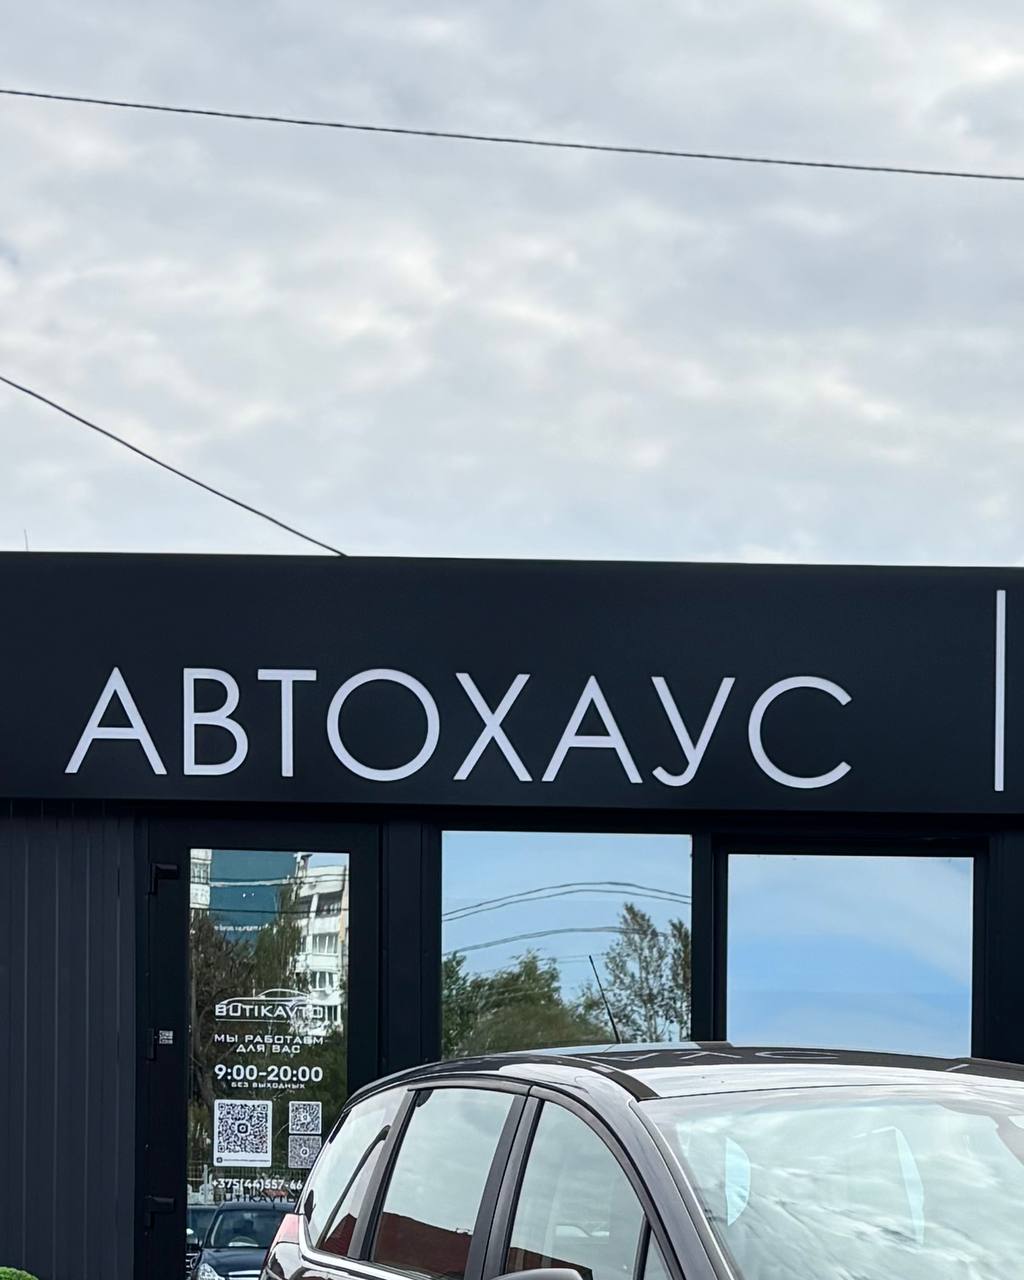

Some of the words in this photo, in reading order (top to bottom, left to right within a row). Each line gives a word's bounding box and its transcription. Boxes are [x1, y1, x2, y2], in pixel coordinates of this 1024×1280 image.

[64, 667, 852, 788] АВТОХАУС
[214, 1004, 323, 1019] BUTIKAVTO
[214, 1034, 239, 1043] МЫ
[245, 1034, 324, 1045] РАБОТАЕМ
[236, 1044, 266, 1053] ДЛЯ
[271, 1044, 301, 1053] ВАС
[214, 1064, 323, 1082] 9:00-20:00
